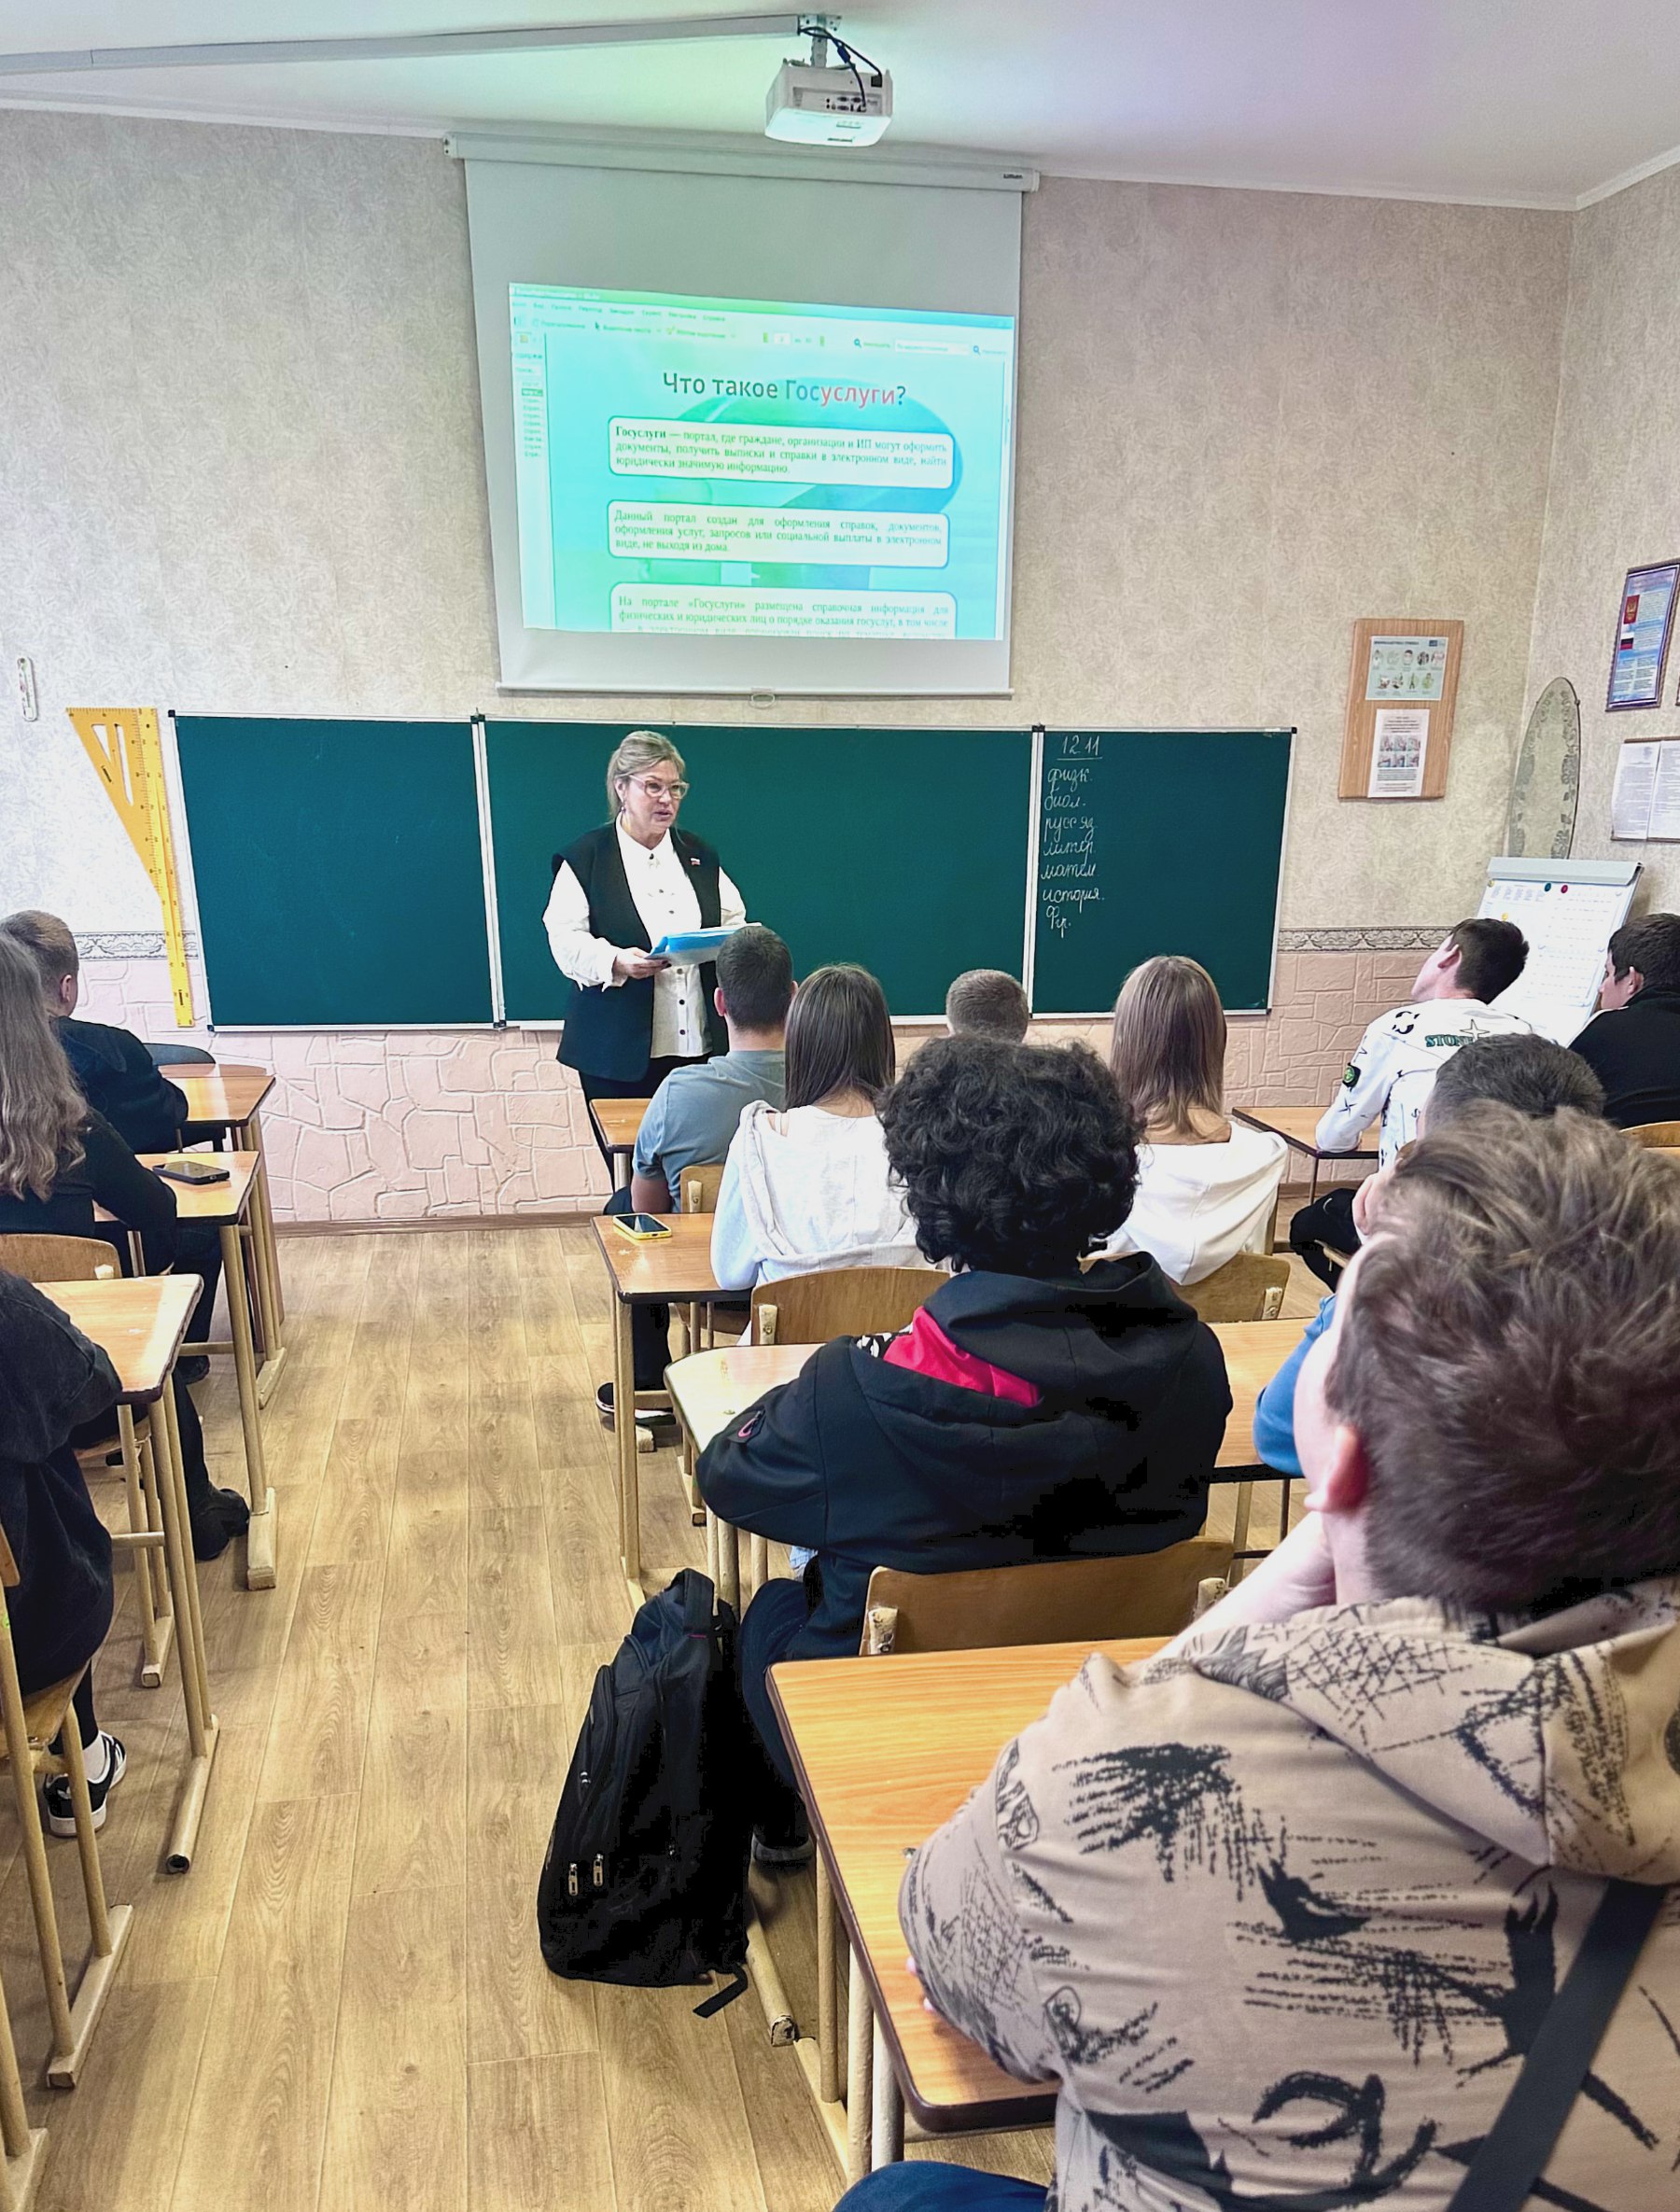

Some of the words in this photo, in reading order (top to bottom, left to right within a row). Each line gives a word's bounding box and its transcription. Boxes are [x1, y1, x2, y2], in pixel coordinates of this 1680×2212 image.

[663, 372, 706, 394] Что
[712, 378, 778, 399] такое
[786, 379, 906, 409] Госуслуги?
[616, 426, 666, 440] Госуслуги
[683, 431, 719, 443] портал,
[721, 435, 735, 443] где
[738, 434, 785, 447] граждане,
[788, 438, 845, 449] организации
[857, 439, 872, 449] ИП
[875, 441, 901, 453] могут
[903, 440, 946, 454] оформить
[616, 442, 671, 455] документы,
[676, 445, 720, 457] получить
[724, 449, 764, 458] выписки
[780, 451, 817, 462] справки
[832, 455, 889, 466] электронном
[893, 456, 917, 466] виде,
[616, 456, 675, 469] юридически
[678, 459, 724, 471] значимую
[614, 510, 652, 522] Данный
[665, 513, 696, 525] портал
[707, 515, 737, 525] создан
[748, 517, 764, 526] для
[775, 517, 831, 530] оформления
[840, 521, 878, 532] справок,
[615, 525, 673, 537] оформления
[678, 528, 706, 539] услуг,
[709, 529, 750, 541] запросов
[756, 531, 772, 539] или
[777, 532, 829, 542] социальной
[833, 534, 872, 543] выплаты
[887, 536, 942, 547] электронном
[615, 539, 640, 549] виде,
[642, 540, 653, 549] не
[656, 541, 690, 552] выходя
[619, 595, 632, 606] На
[642, 598, 679, 609] портале
[688, 597, 745, 611] «Госуслуги»
[755, 602, 803, 612] размещена
[812, 604, 862, 614] справочная
[871, 603, 925, 615] информация
[933, 607, 948, 615] для
[619, 609, 675, 623] физических
[685, 613, 747, 624] юридических
[750, 615, 767, 624] лиц
[777, 615, 813, 627] порядке
[815, 617, 854, 625] оказания
[857, 618, 896, 628] госуслуг,
[905, 619, 921, 627] том
